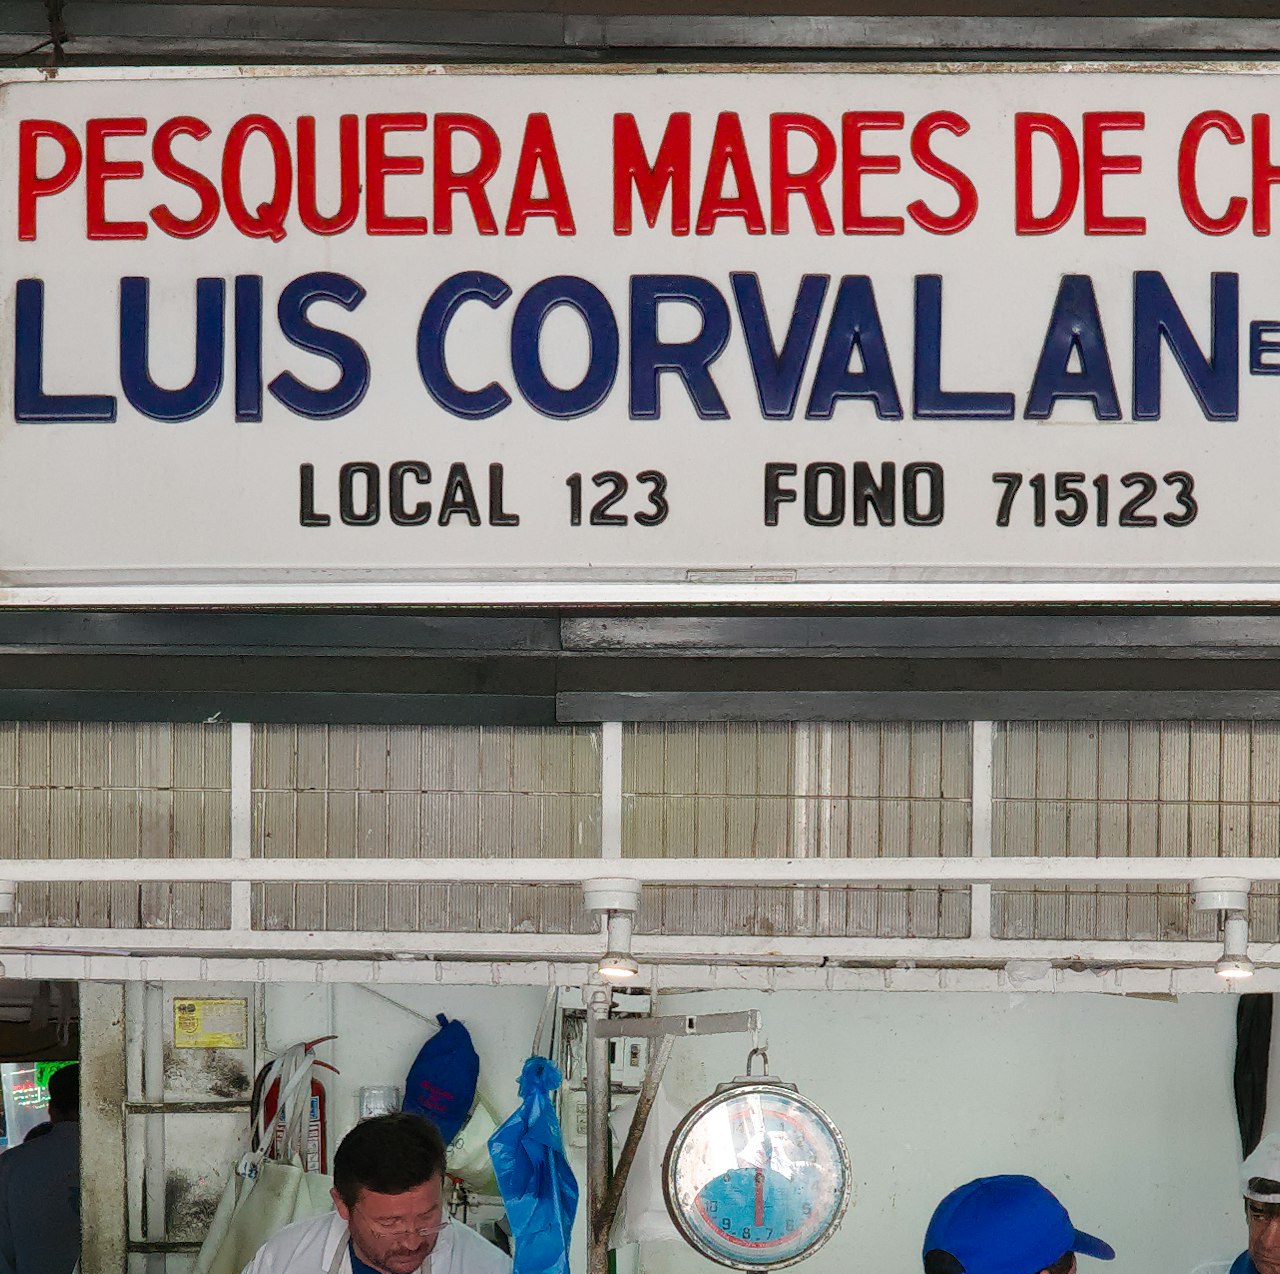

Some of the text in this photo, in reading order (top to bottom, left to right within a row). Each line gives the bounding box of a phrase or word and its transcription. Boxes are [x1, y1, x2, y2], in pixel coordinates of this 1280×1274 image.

[18, 112, 576, 243] PESQUERA
[612, 110, 977, 238] MARES
[1015, 112, 1143, 237] DE
[13, 270, 368, 423] LUIS
[415, 270, 1239, 422] CORVALAN
[298, 461, 1198, 528] LOCAL 123 FONO 715123
[722, 1218, 731, 1231] 9
[743, 1227, 751, 1240] 8
[766, 1227, 774, 1240] 7
